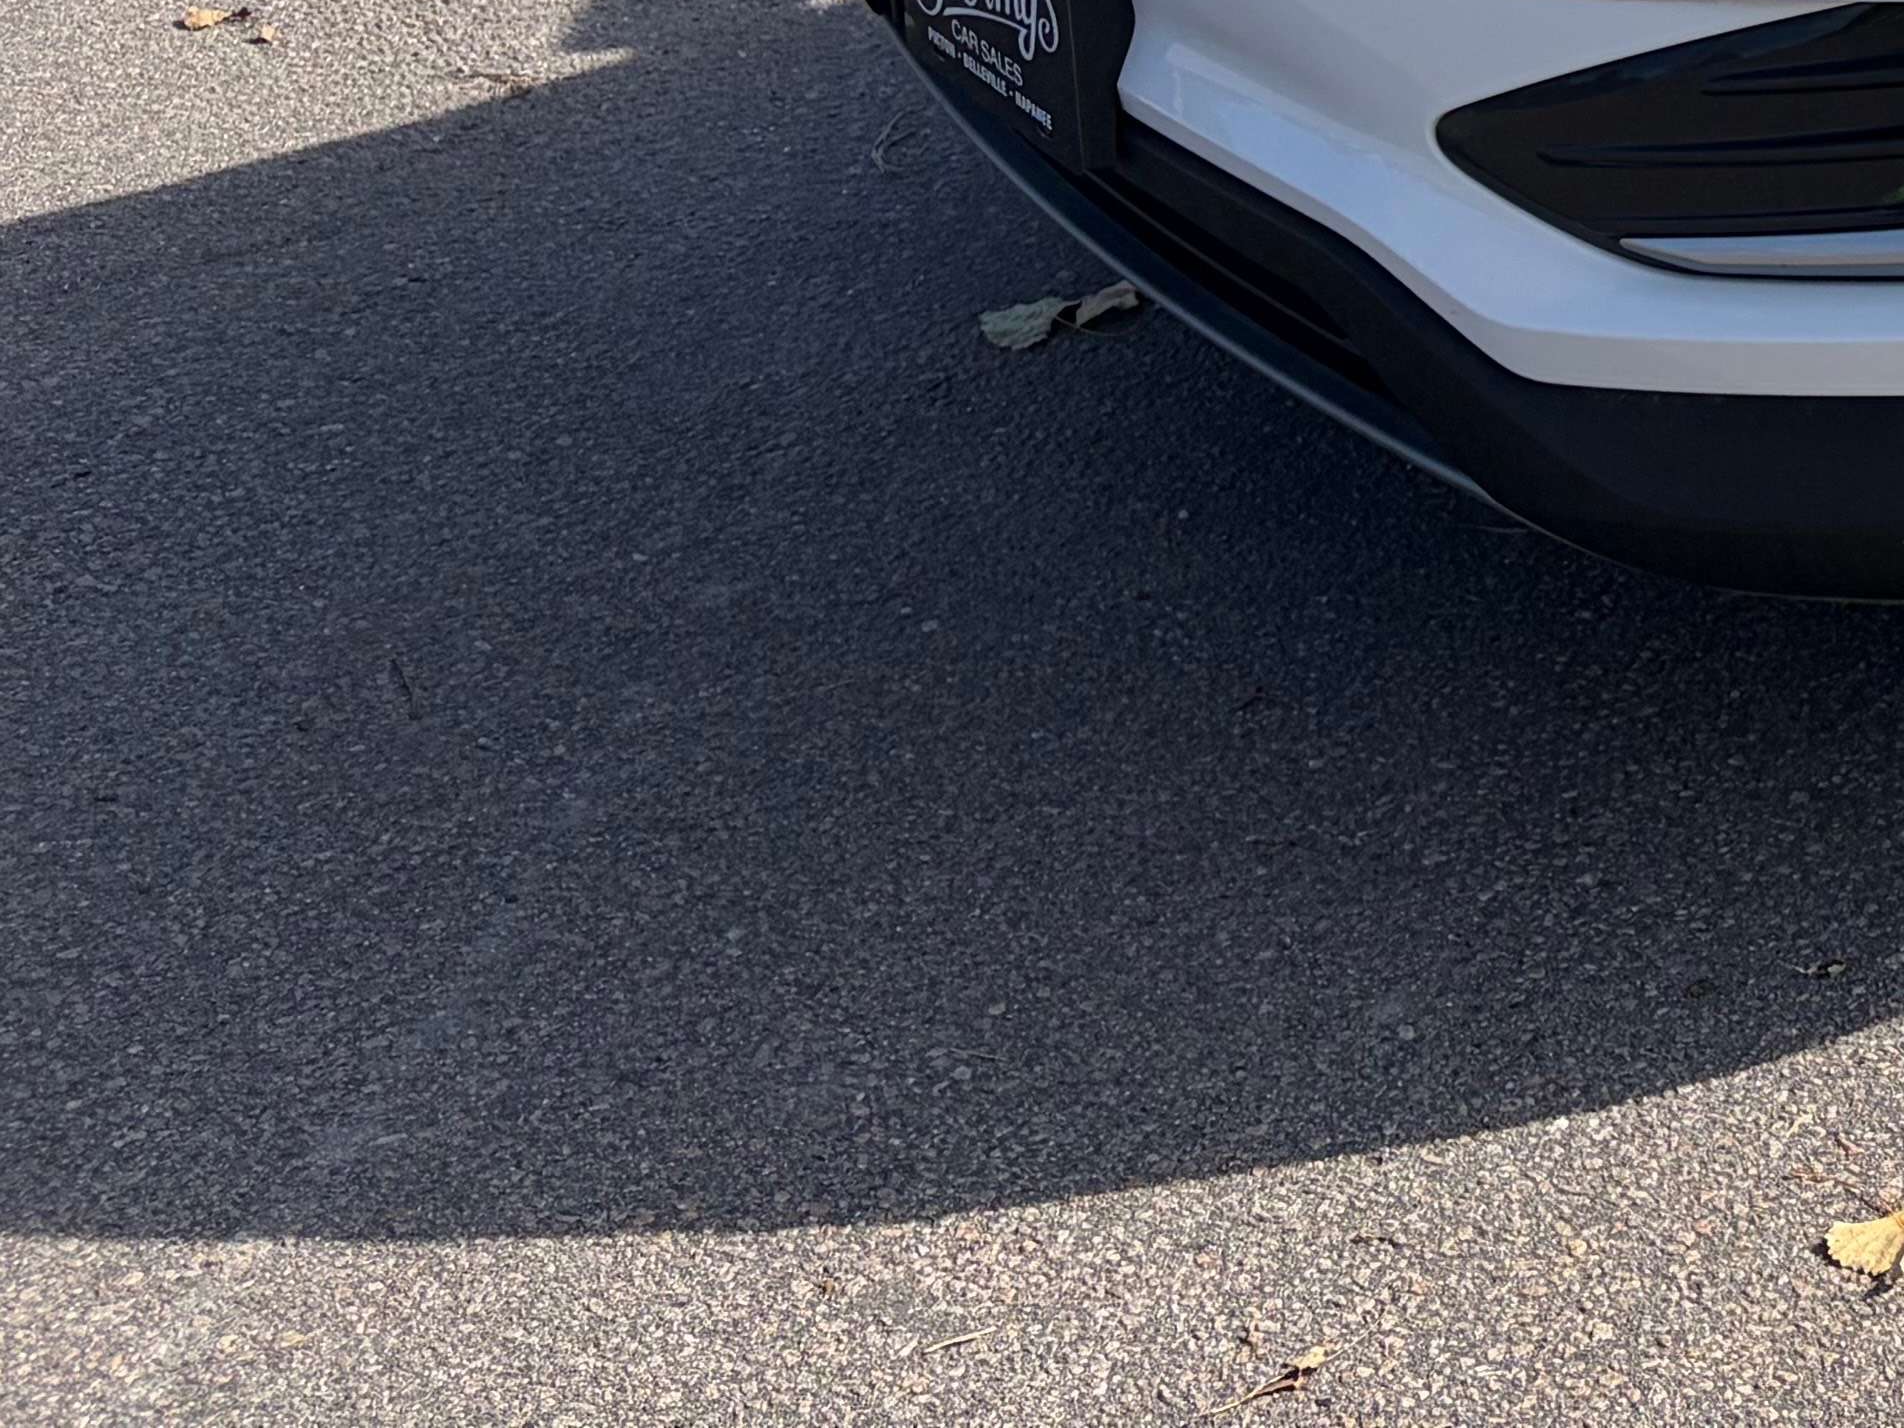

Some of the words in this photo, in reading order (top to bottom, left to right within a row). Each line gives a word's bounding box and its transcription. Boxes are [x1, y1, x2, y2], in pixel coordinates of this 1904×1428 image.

[951, 19, 979, 57] CAR
[981, 39, 1023, 87] SALES
[963, 51, 1008, 98] BELLEVILLE
